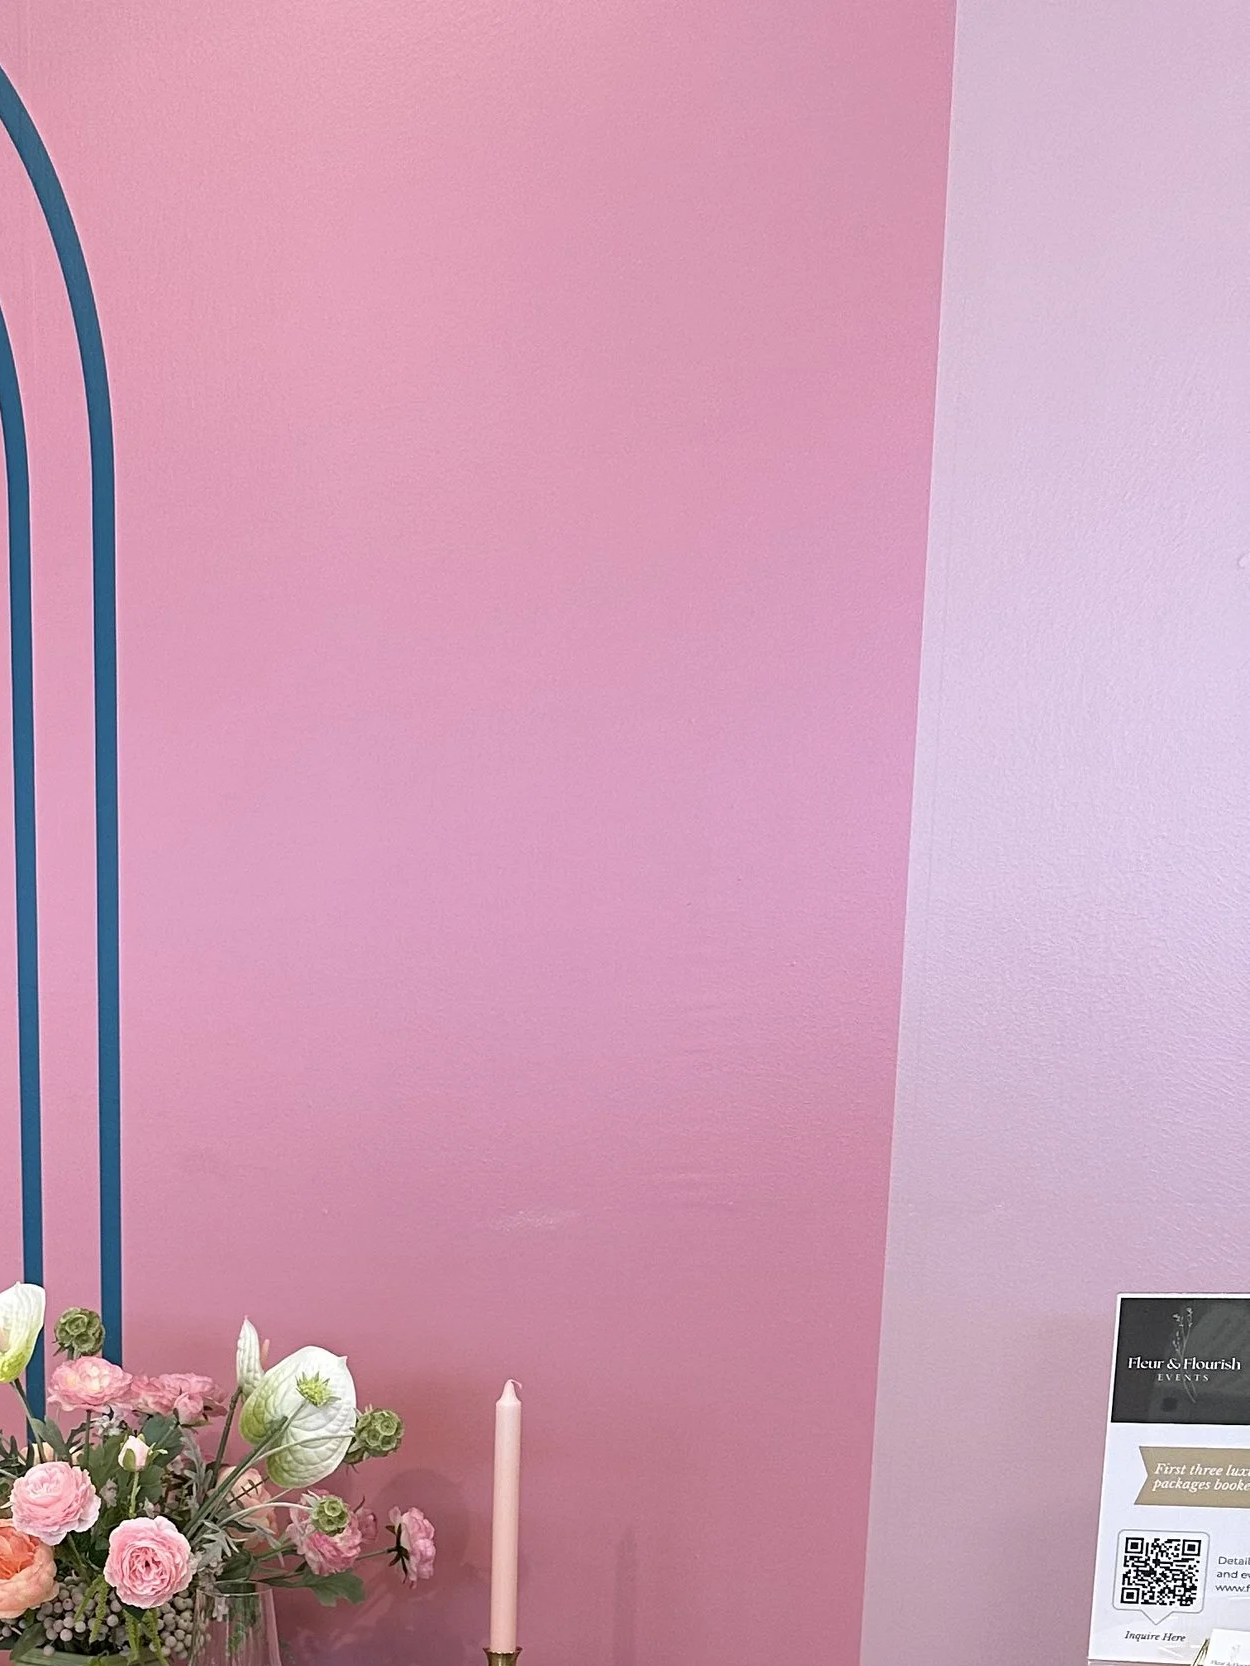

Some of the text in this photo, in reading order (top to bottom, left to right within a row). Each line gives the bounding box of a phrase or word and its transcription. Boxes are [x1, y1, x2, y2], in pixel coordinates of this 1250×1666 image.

[1128, 1356, 1241, 1370] Fleur & Flourish
[1157, 1373, 1209, 1381] EVENTS
[1154, 1462, 1186, 1475] First
[1190, 1463, 1223, 1476] three
[1152, 1477, 1211, 1493] packages
[1216, 1570, 1238, 1579] and
[1125, 1630, 1186, 1642] Inquire Here
